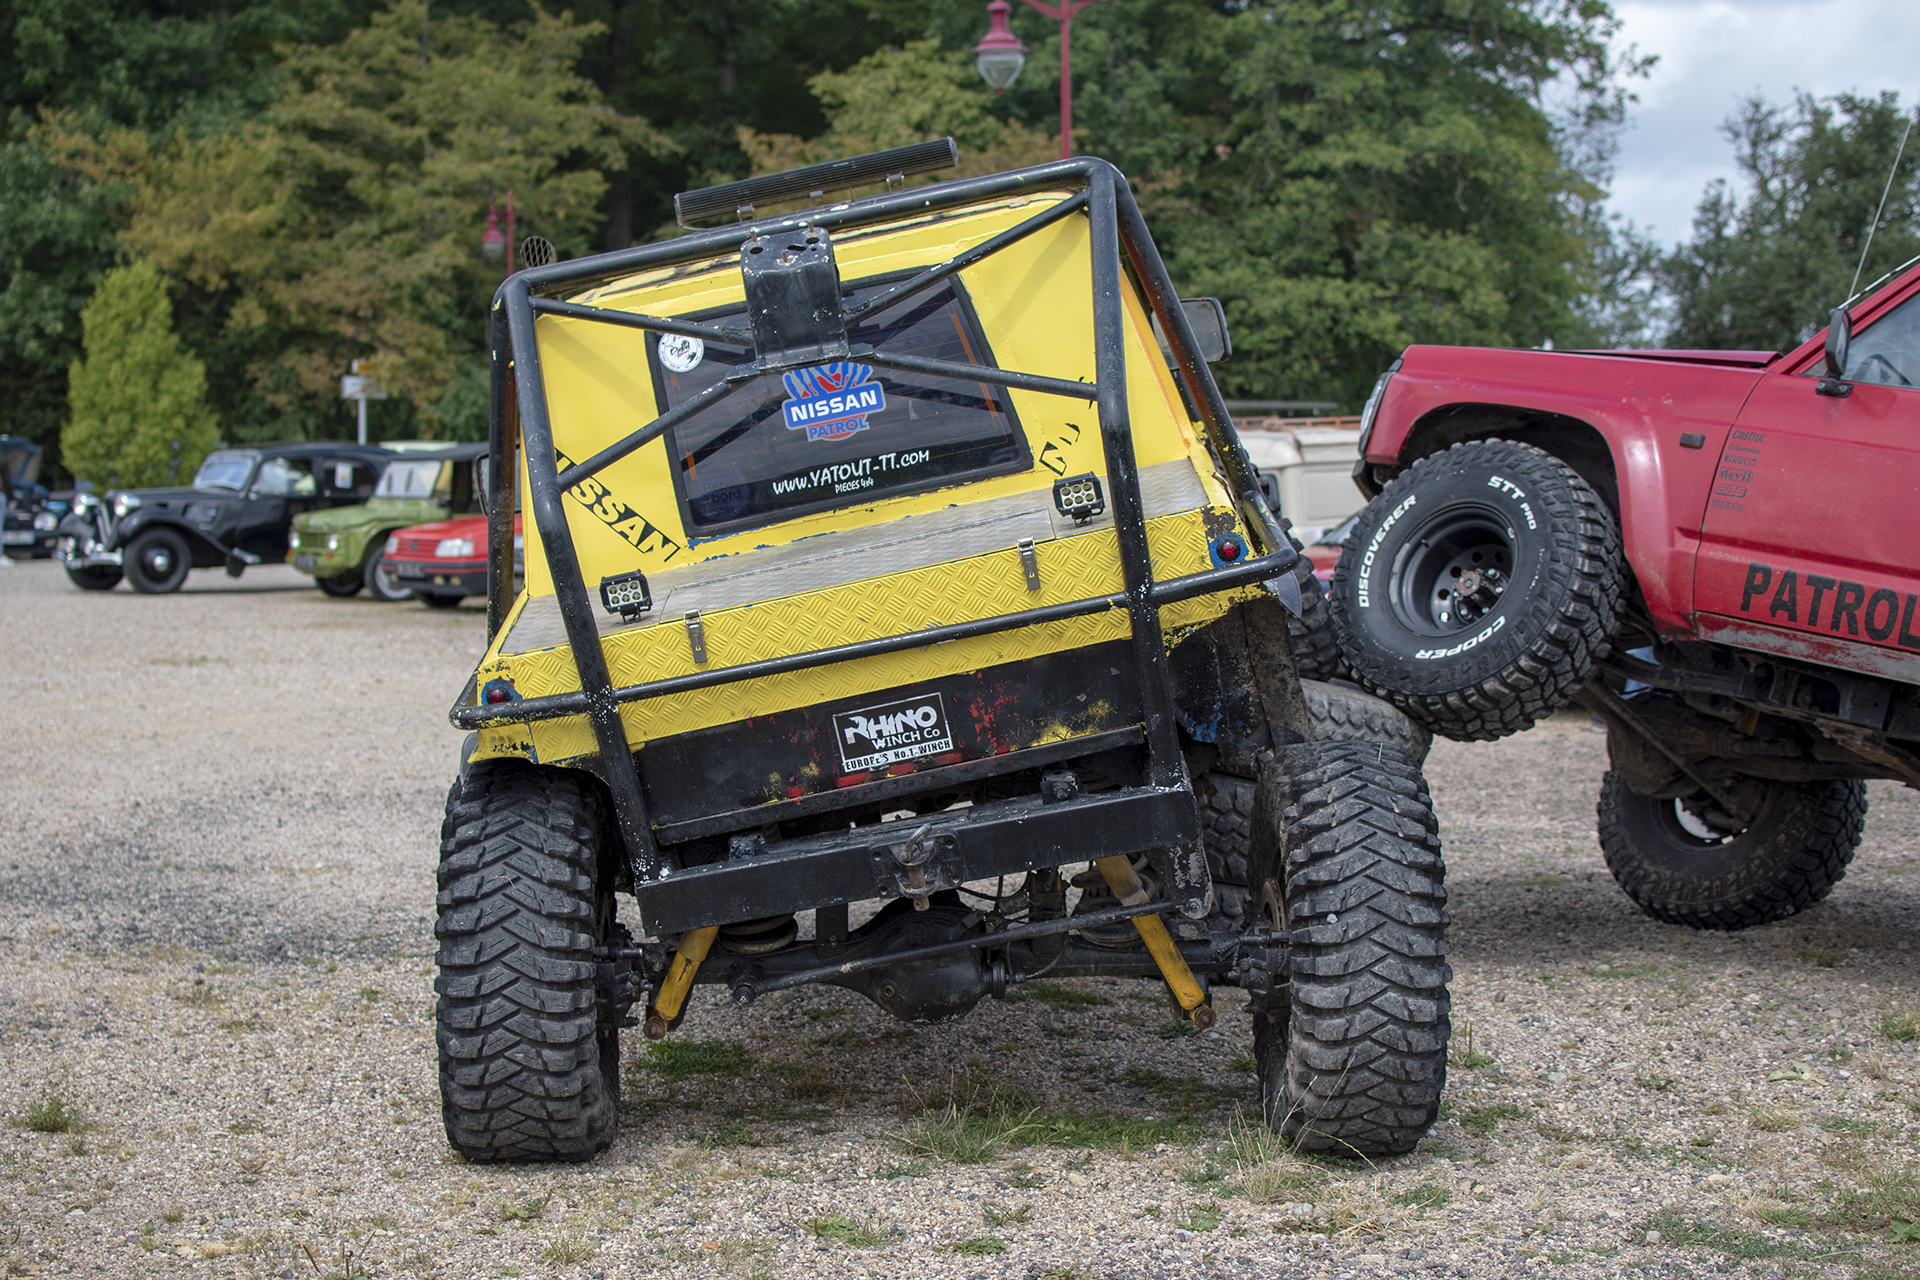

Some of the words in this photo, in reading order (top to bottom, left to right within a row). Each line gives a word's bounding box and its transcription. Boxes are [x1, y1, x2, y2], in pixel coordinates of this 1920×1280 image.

[791, 390, 877, 422] NISSAN
[808, 416, 867, 439] PATROL
[1732, 429, 1766, 443] Castrol
[1735, 444, 1760, 455] brembo
[835, 479, 860, 494] PIECES
[1720, 469, 1752, 482] devil
[1714, 483, 1748, 498] BBS
[1487, 475, 1525, 500] STT
[1520, 502, 1537, 530] PRO
[1711, 499, 1744, 510] sparco
[1358, 495, 1417, 608] DISCOVERER
[1740, 561, 1920, 650] PATROL
[1415, 615, 1506, 660] COOPER
[844, 706, 937, 744] RHINO
[872, 730, 921, 750] WINCH
[923, 728, 940, 739] Co
[918, 739, 950, 755] WINCH
